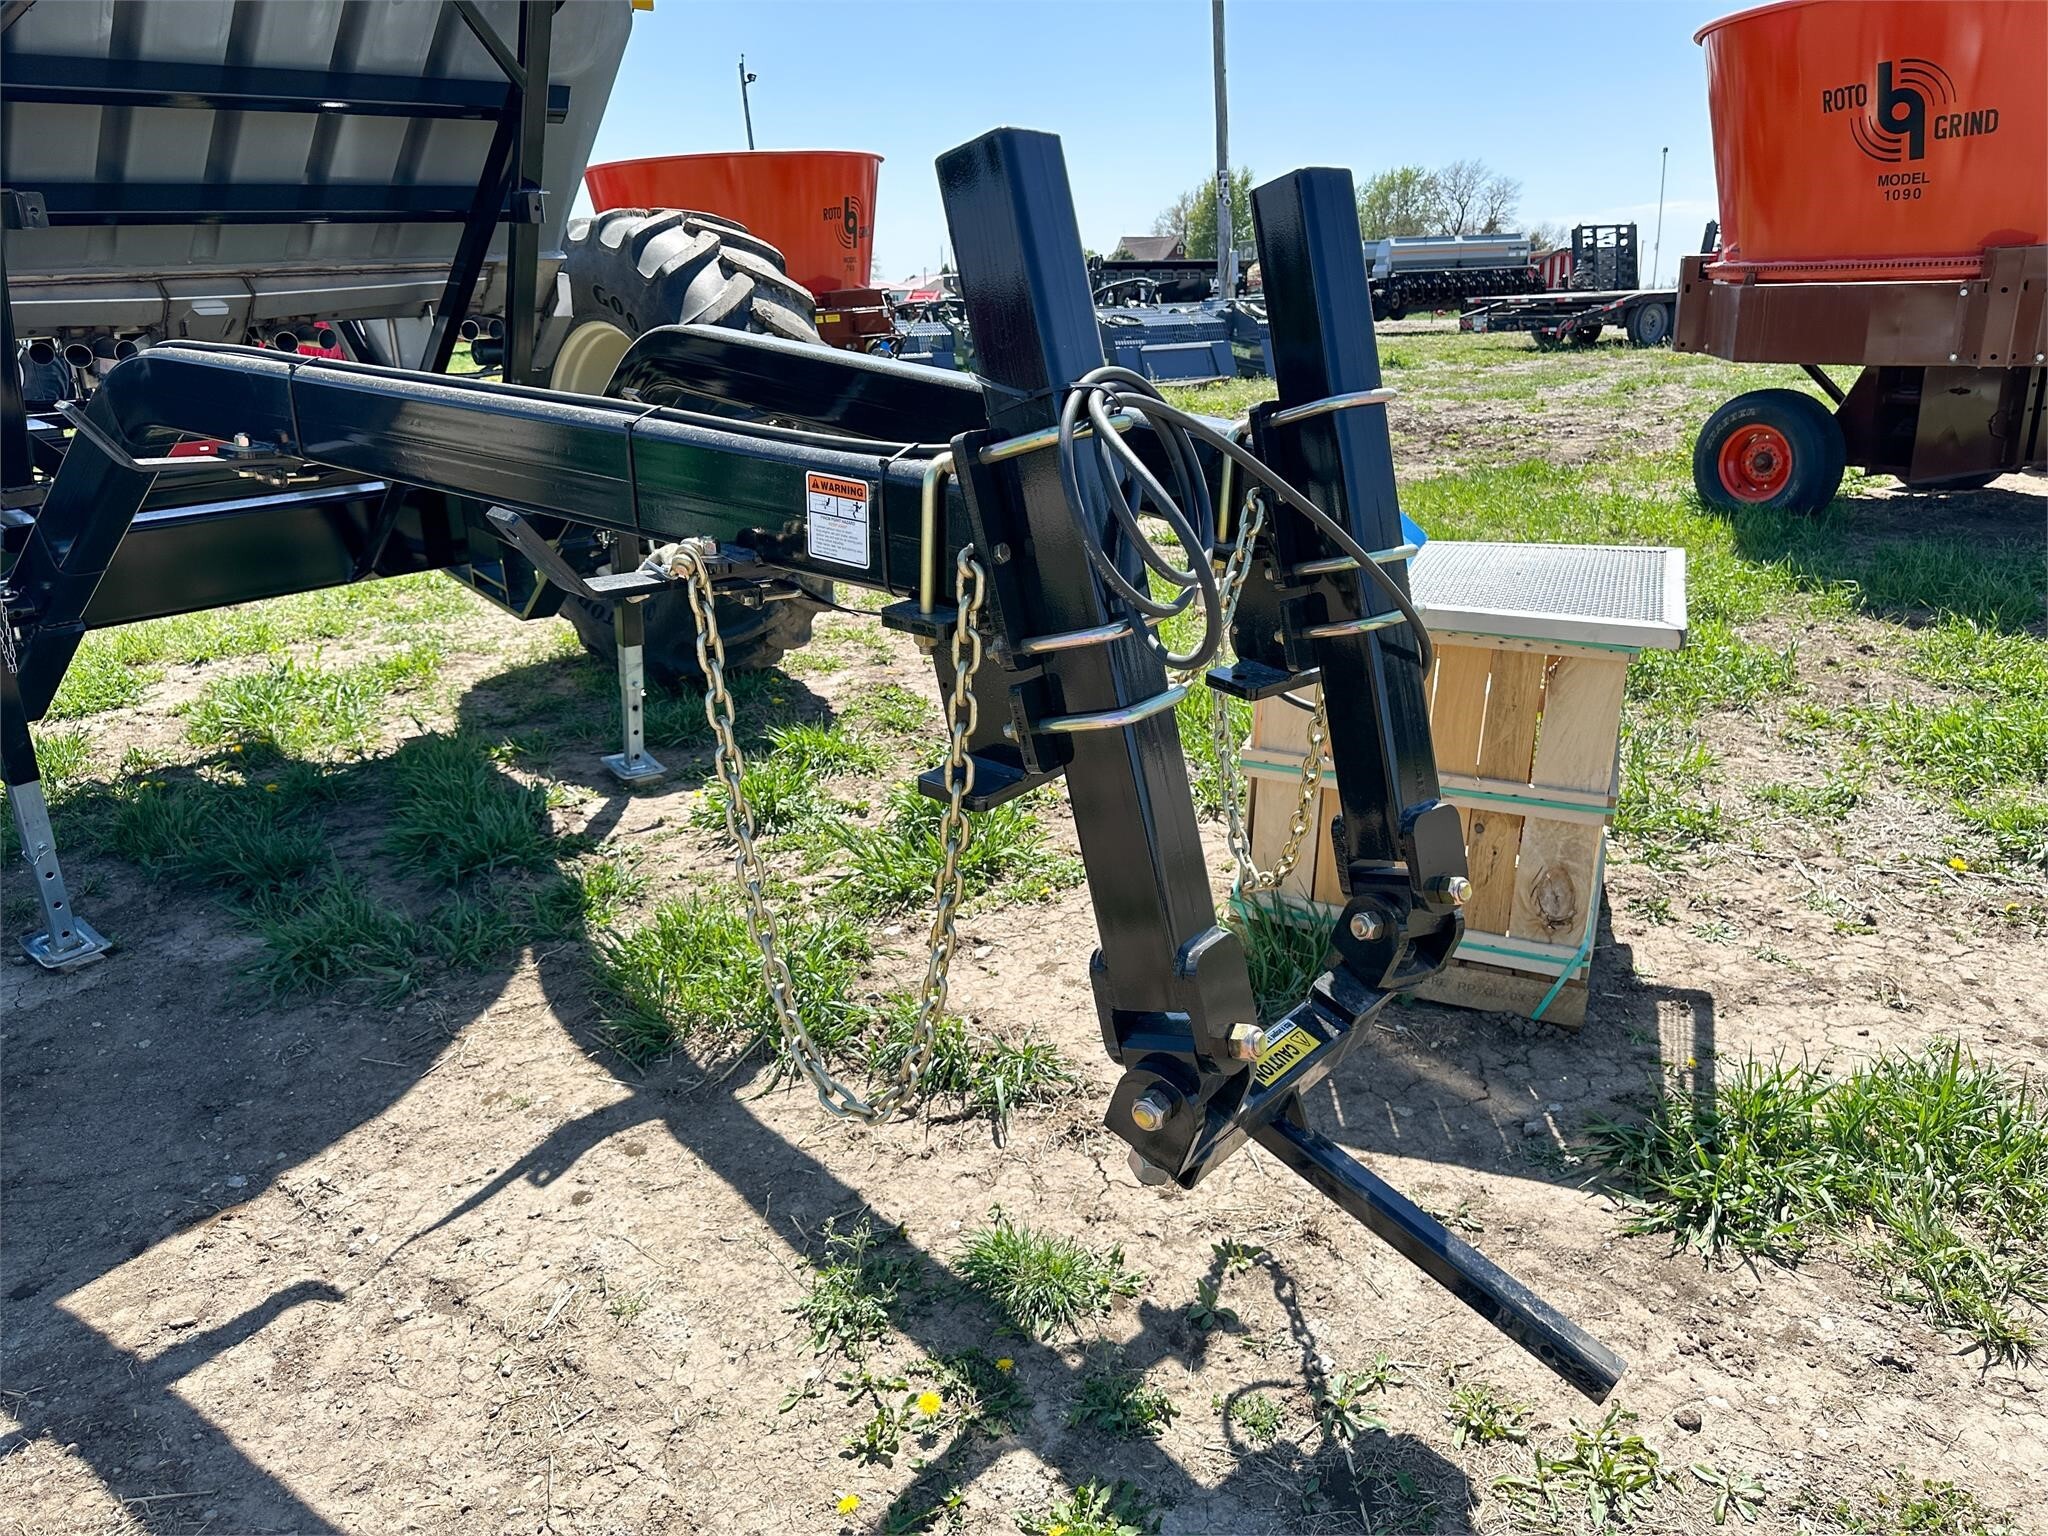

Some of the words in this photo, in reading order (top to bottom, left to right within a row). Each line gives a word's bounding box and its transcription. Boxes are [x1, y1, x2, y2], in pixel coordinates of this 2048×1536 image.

[1822, 83, 1867, 113] ROTO
[1934, 108, 1999, 140] GRIND
[1877, 172, 1930, 187] MODEL
[1884, 188, 1922, 201] 1090
[823, 207, 842, 221] ROTO
[820, 480, 864, 498] WARNING
[1255, 1043, 1301, 1083] CAUTION
